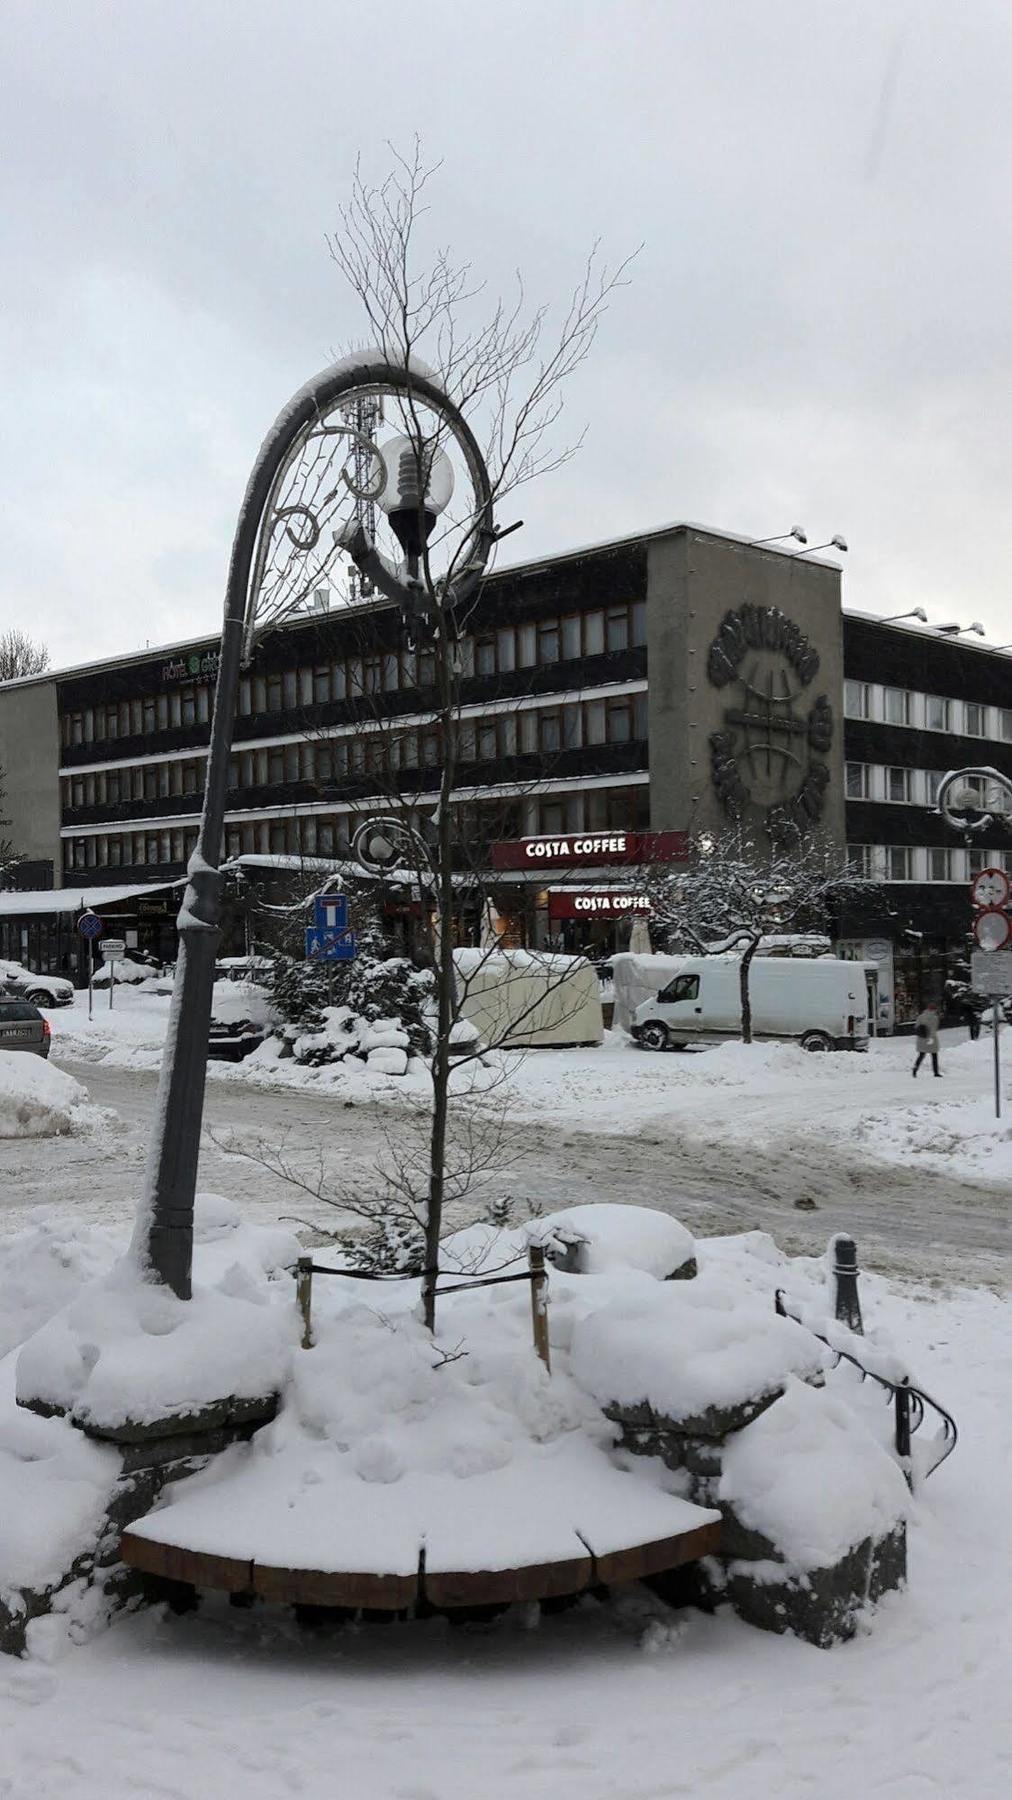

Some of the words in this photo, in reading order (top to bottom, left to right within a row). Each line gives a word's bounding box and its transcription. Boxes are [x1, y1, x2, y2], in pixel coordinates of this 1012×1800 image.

[525, 841, 570, 858] COSTA
[573, 837, 626, 855] COFFEE
[574, 897, 610, 911] COSTA
[612, 896, 651, 910] COFFEE
